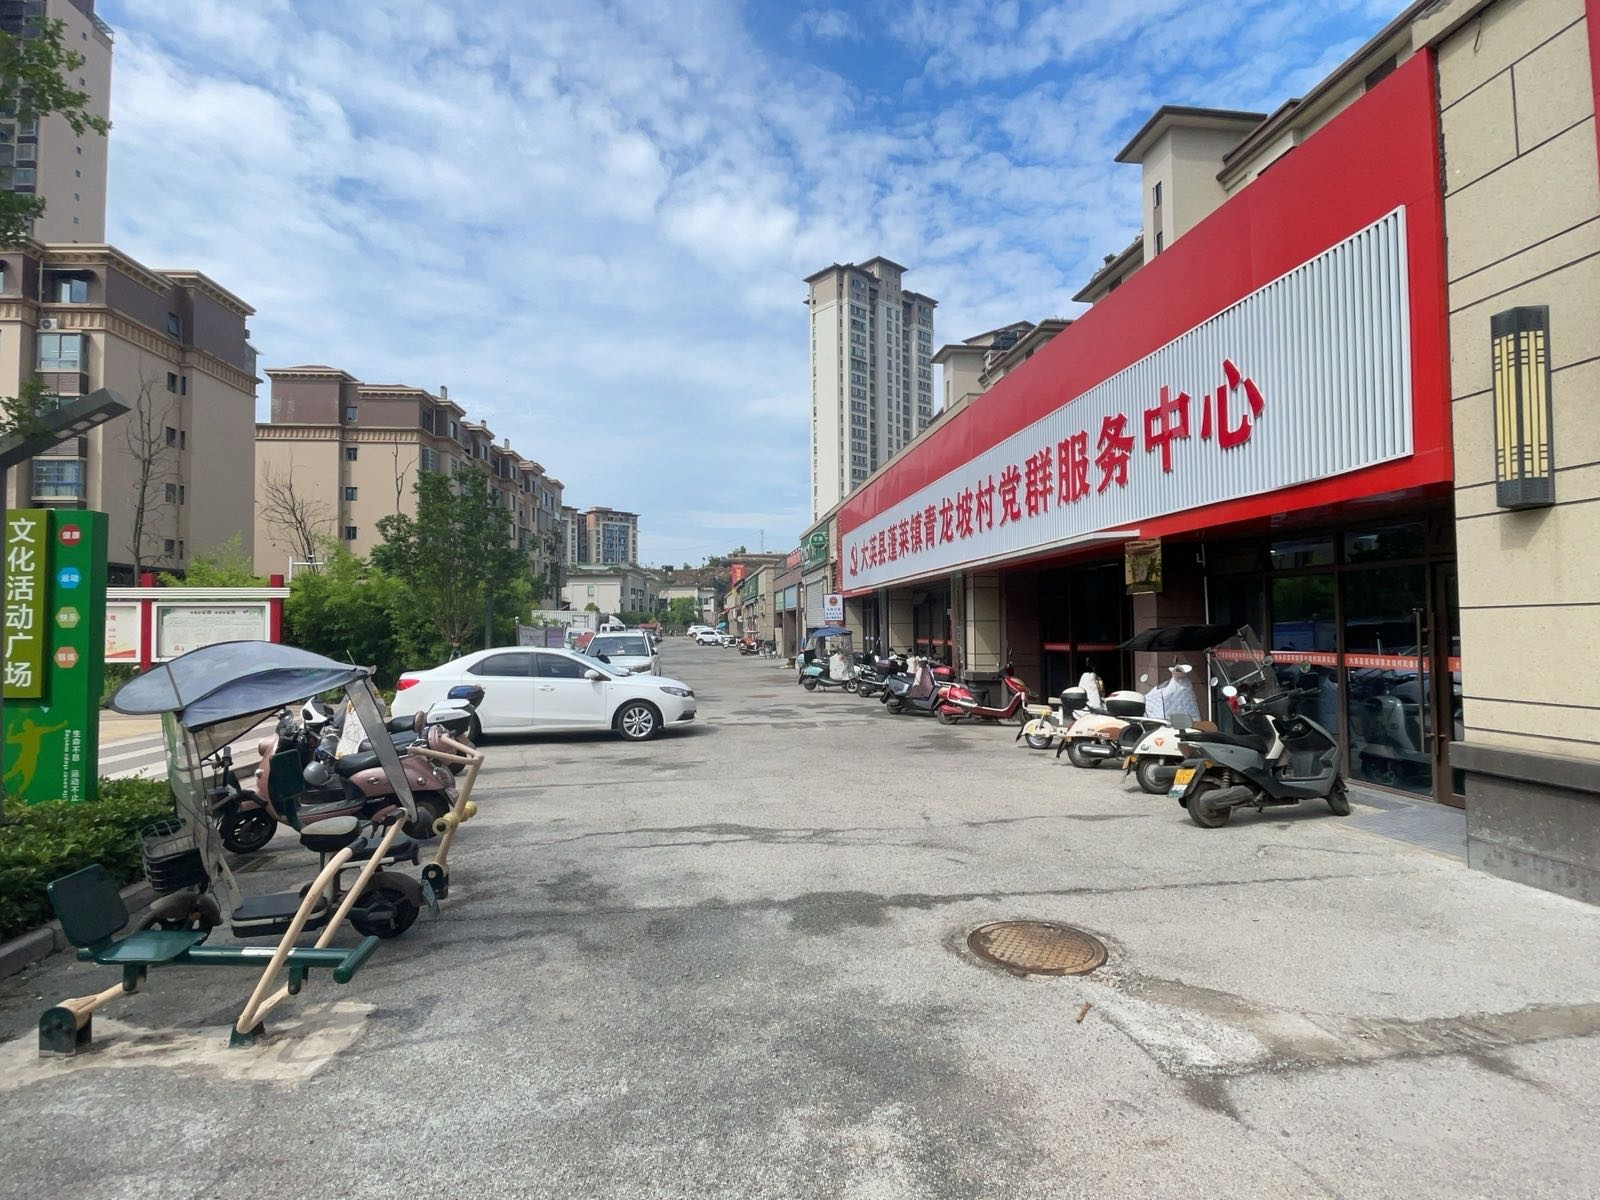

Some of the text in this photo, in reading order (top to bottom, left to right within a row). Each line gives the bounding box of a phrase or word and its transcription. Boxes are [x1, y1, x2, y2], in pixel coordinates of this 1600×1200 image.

[860, 357, 1265, 573] 大英县蓬莱镇青龙坡村党群服务中心
[62, 531, 80, 540] 健康
[61, 573, 79, 583] 运动
[4, 517, 37, 687] 文化活动广场
[59, 613, 78, 622] 快乐
[58, 653, 76, 662] 锻炼
[71, 730, 81, 801] 生命不息 运动不止
